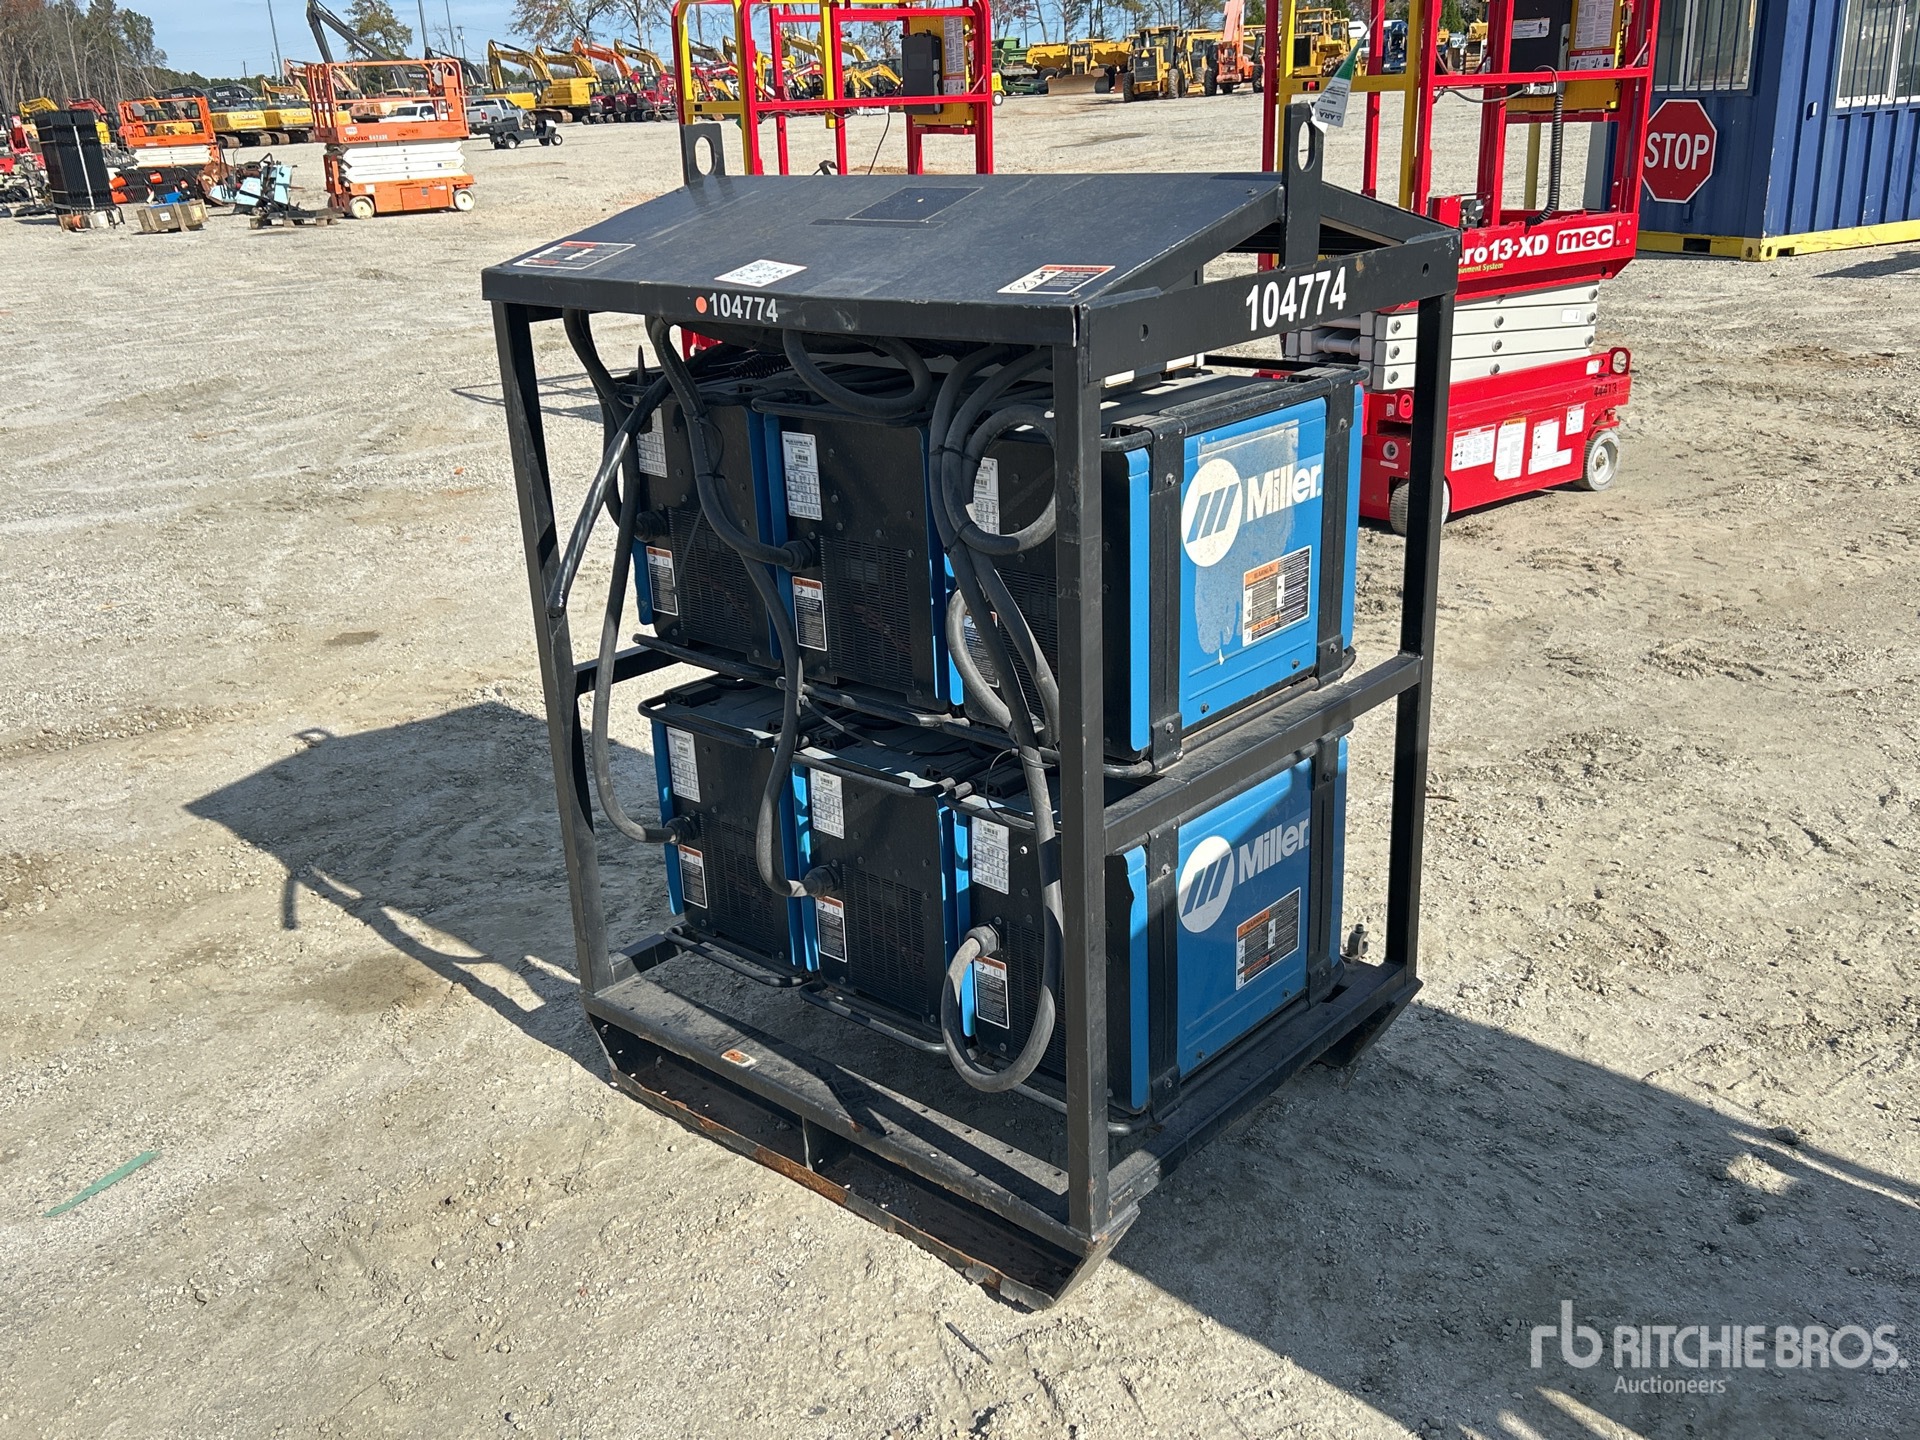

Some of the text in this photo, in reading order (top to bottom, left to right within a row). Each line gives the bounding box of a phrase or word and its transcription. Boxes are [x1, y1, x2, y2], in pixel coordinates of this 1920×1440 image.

[1644, 132, 1710, 170] STOP
[1458, 234, 1549, 265] ro13-XD
[1557, 228, 1612, 251] mec
[1482, 263, 1504, 272] System
[709, 292, 779, 322] 104774
[1246, 266, 1347, 331] 104774
